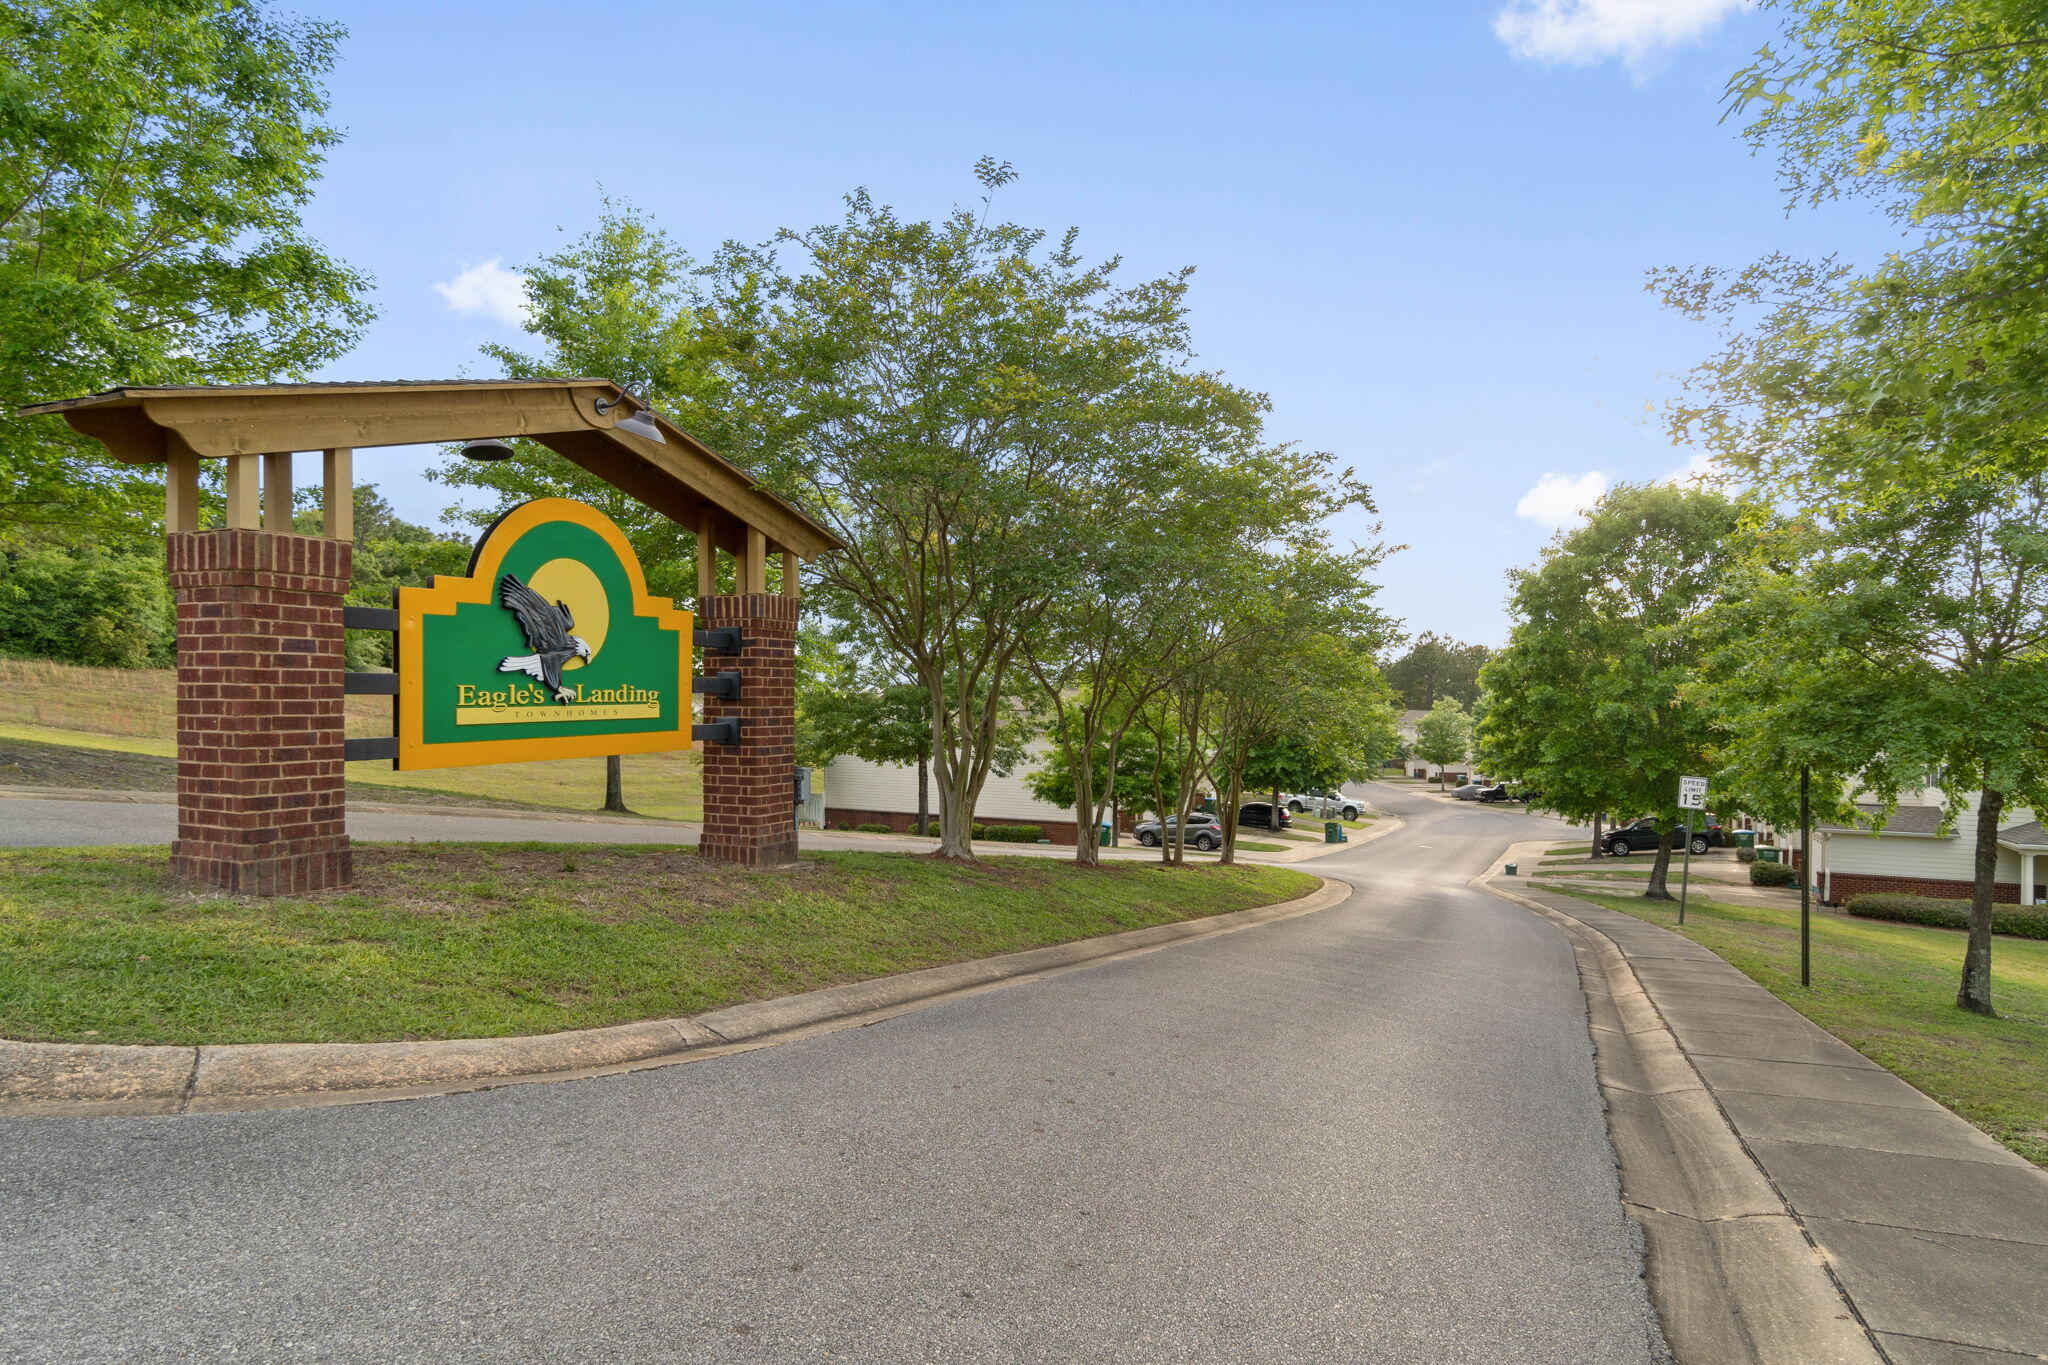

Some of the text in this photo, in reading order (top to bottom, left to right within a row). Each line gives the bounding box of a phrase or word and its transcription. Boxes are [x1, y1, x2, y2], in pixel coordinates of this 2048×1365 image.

[456, 684, 660, 712] Eagle's Landing
[515, 710, 619, 718] TOWNHOMES
[1683, 793, 1701, 806] 15
